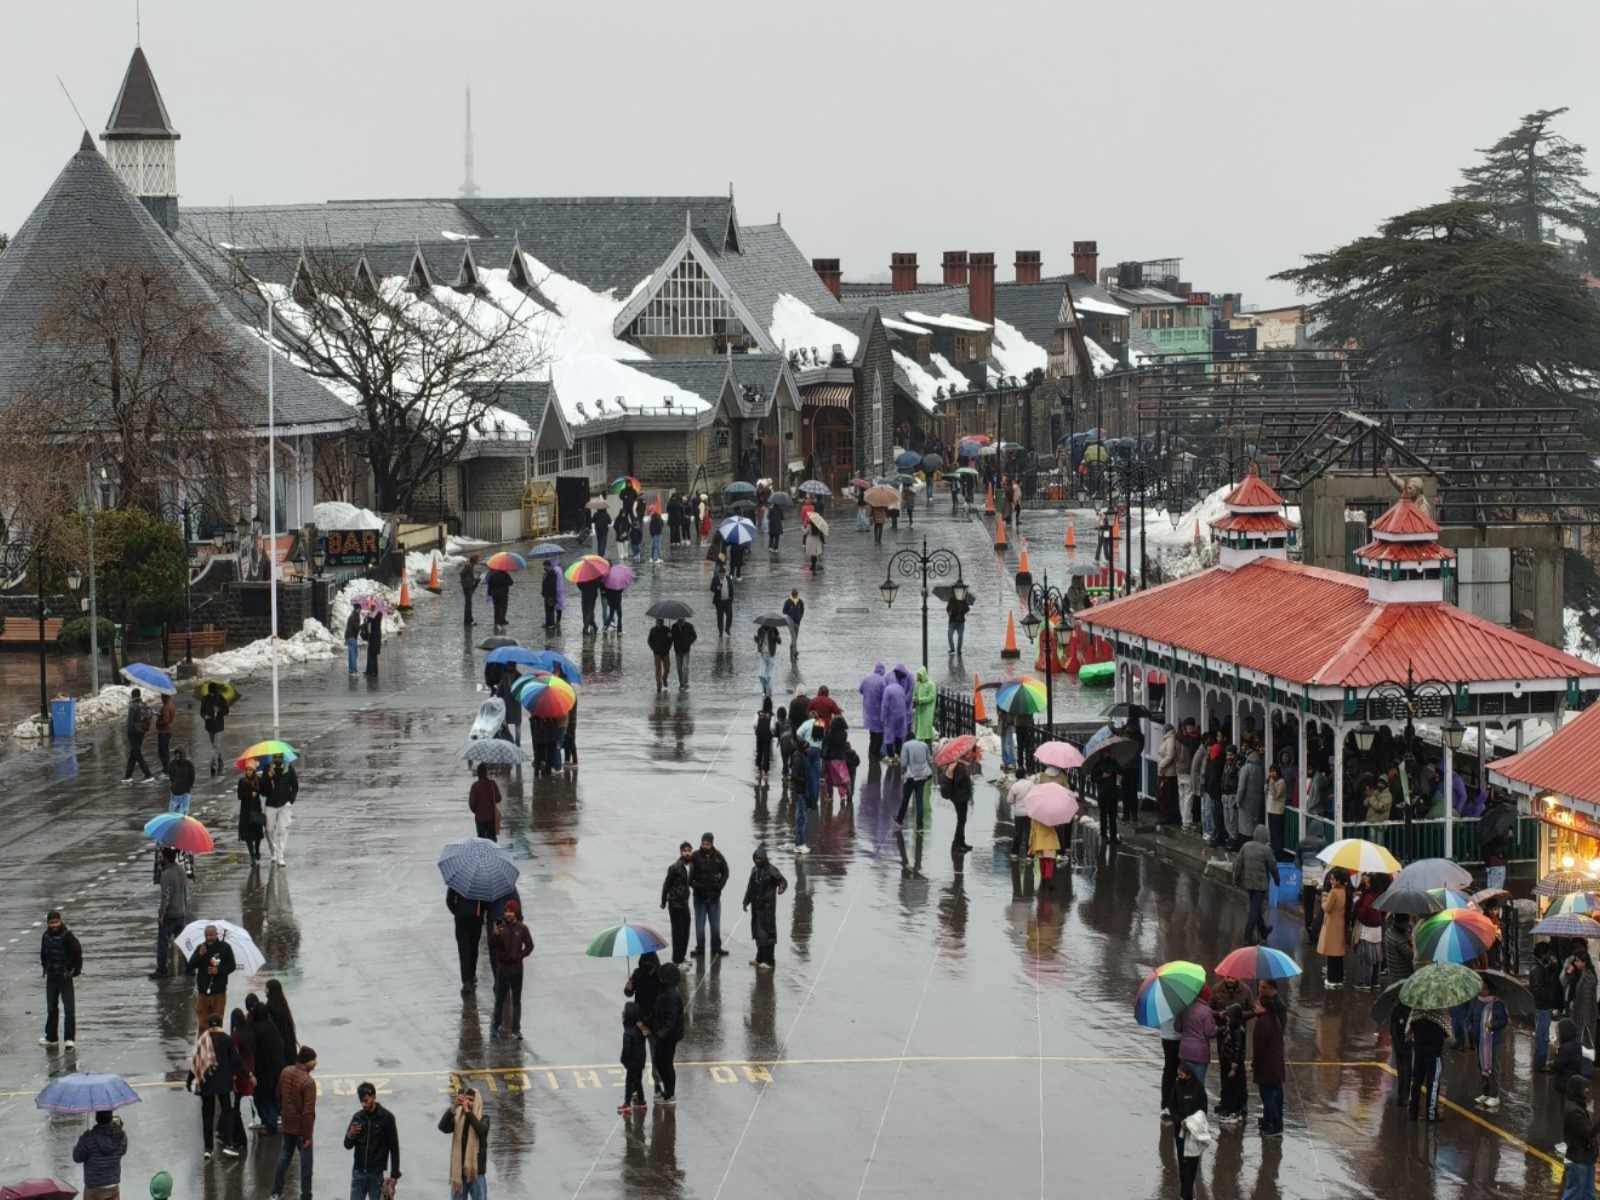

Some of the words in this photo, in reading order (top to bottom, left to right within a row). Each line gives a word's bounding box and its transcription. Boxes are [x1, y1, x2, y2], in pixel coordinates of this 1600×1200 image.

[1188, 294, 1208, 304] BAR
[328, 531, 377, 554] BAR
[709, 1066, 773, 1084] NO
